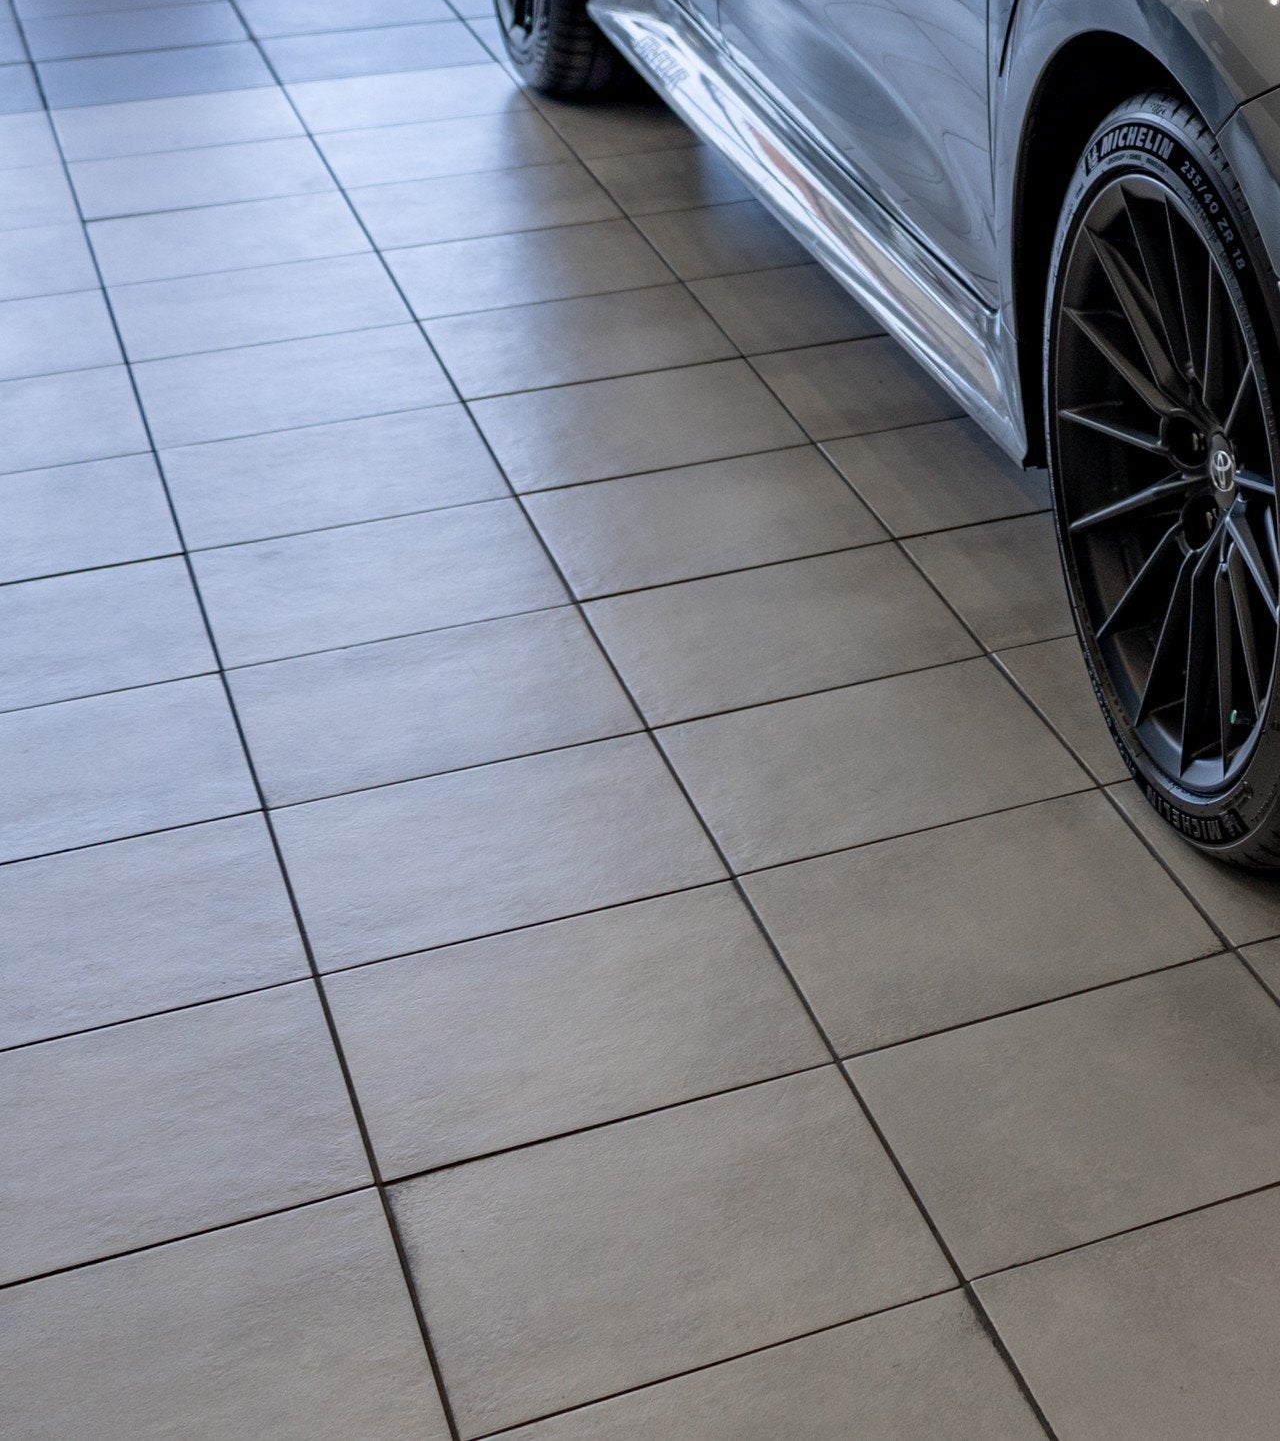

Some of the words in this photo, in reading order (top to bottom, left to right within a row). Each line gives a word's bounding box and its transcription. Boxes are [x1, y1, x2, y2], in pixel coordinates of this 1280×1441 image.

[1100, 125, 1175, 160] MICHELIN
[1180, 160, 1219, 214] 235/40
[1232, 248, 1246, 270] 18
[1146, 784, 1223, 840] MICHELIN
